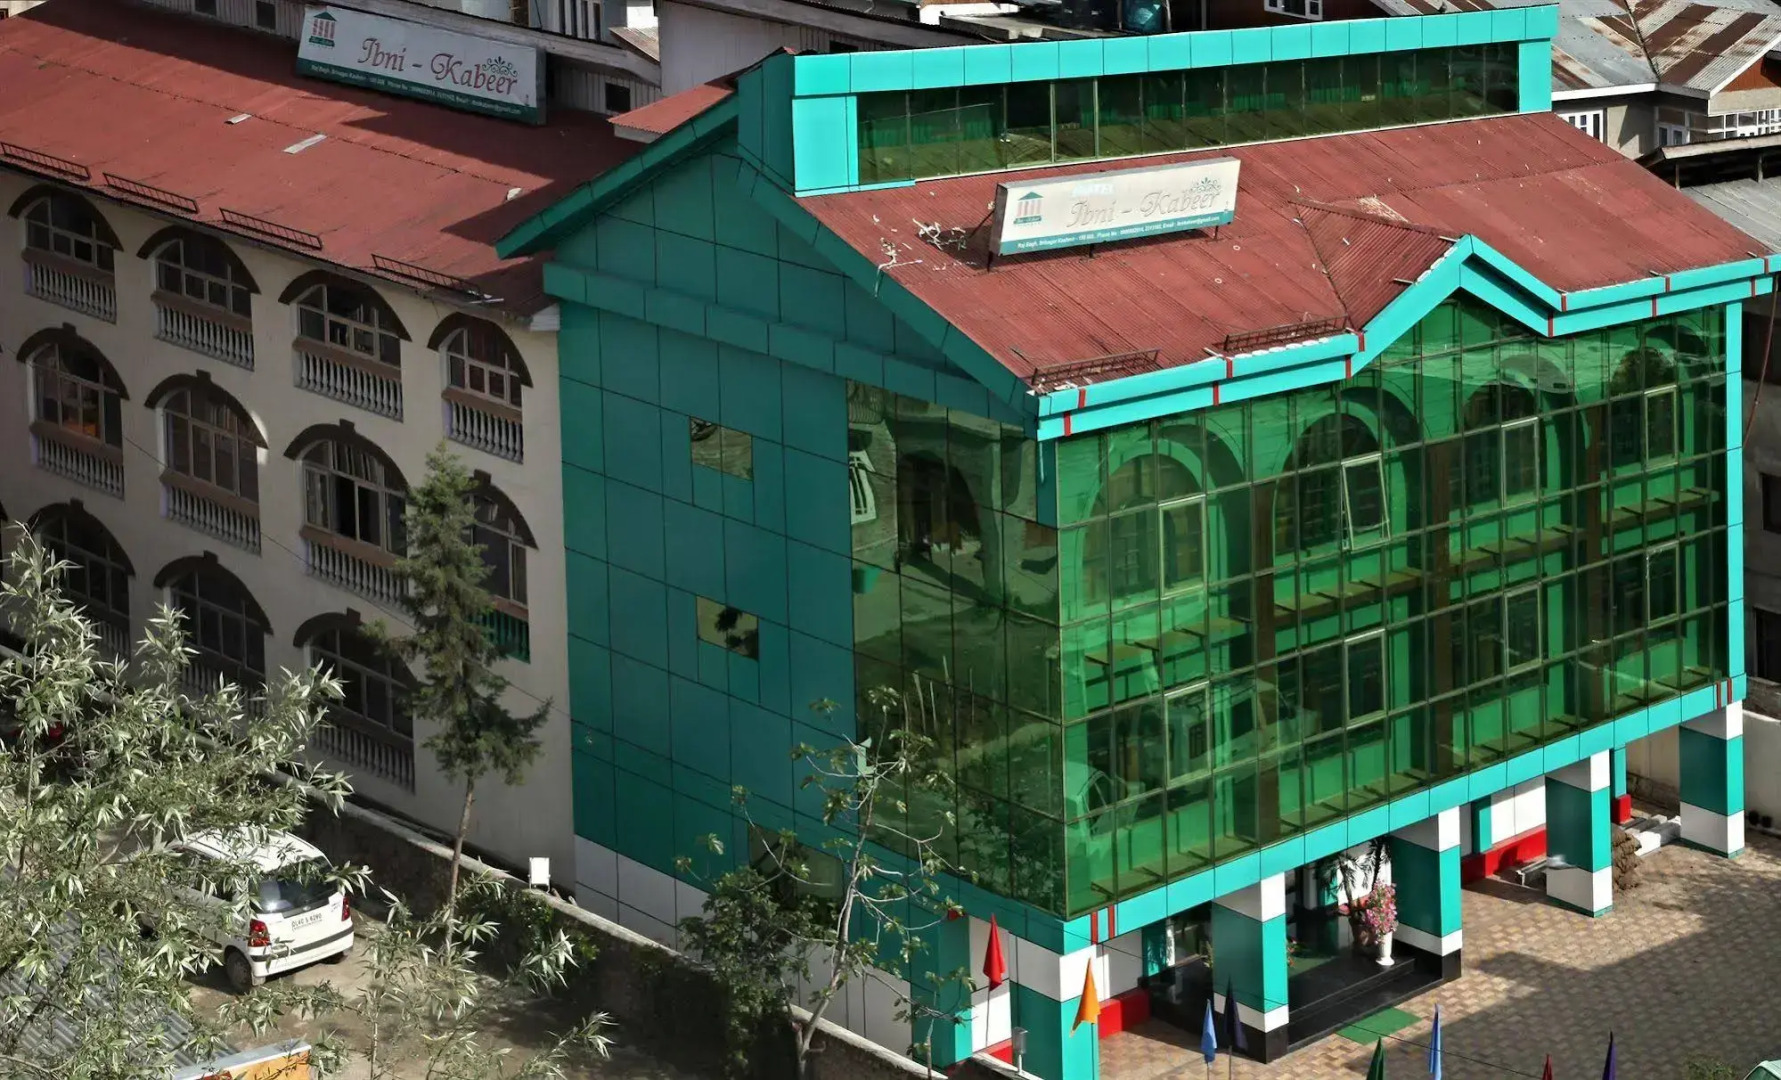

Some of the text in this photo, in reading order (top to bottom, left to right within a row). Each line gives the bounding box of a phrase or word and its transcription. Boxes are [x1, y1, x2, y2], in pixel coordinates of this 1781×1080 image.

[357, 37, 407, 72] Ibni
[430, 53, 518, 95] Kabeer
[1066, 200, 1117, 228] Ibni
[1139, 190, 1221, 218] Kabeer
